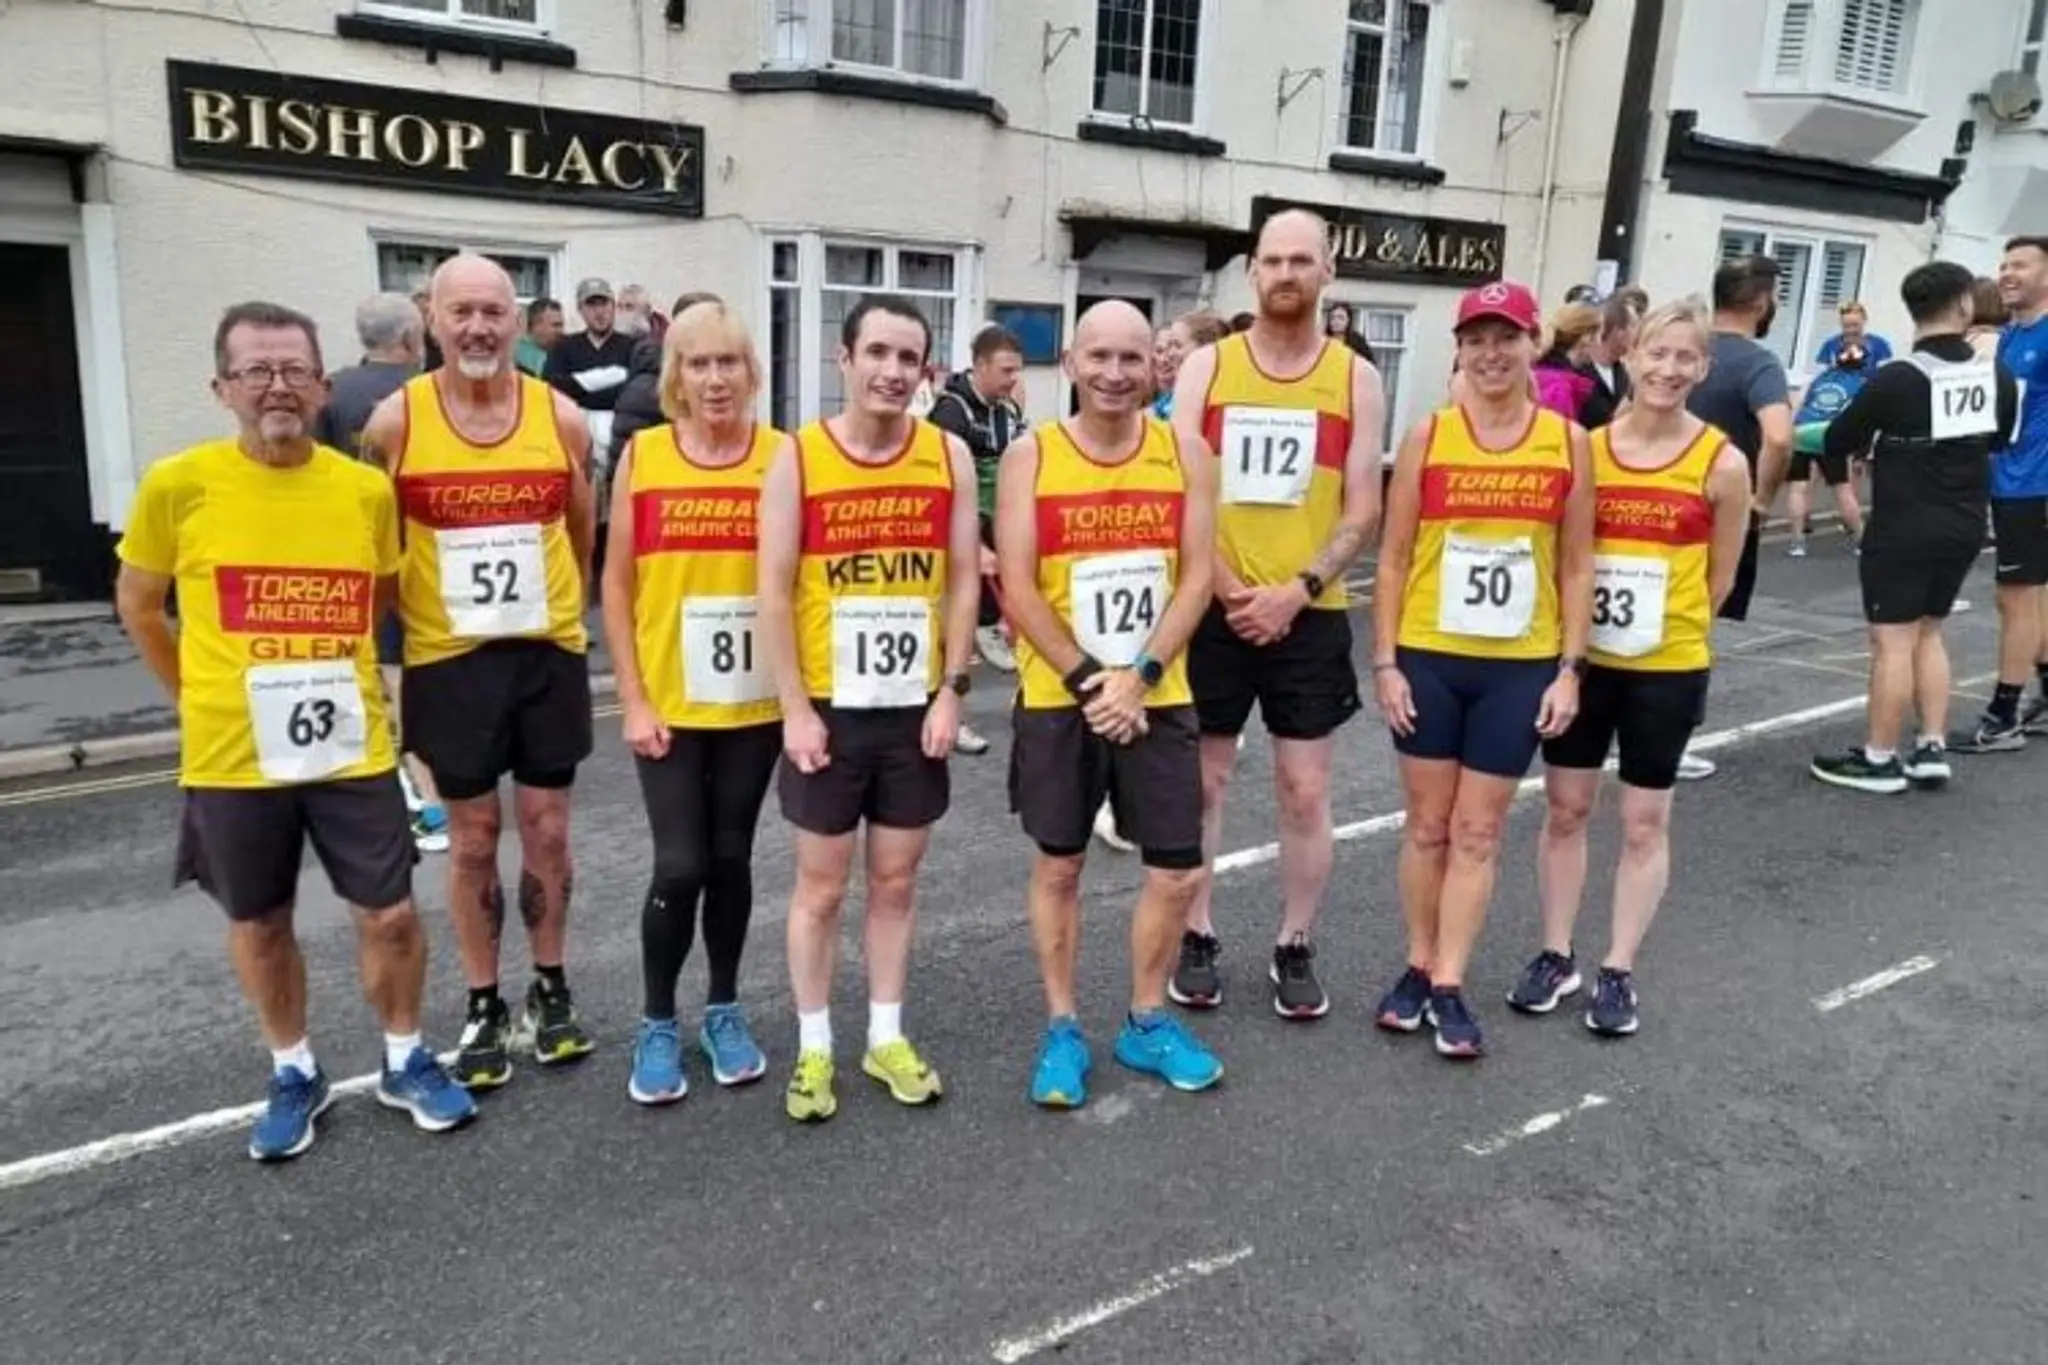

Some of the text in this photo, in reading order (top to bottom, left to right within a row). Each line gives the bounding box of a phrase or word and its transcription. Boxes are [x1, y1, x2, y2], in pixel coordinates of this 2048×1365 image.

[184, 87, 692, 194] BISHOP LACY
[1328, 221, 1498, 273] OD & ALES
[1942, 385, 1987, 417] 170
[1239, 435, 1301, 476] 112
[427, 483, 554, 504] TORBAY
[1444, 472, 1555, 491] TORBAY
[660, 497, 759, 518] TORBA
[820, 496, 932, 523] TORBAY
[1058, 502, 1172, 531] TORBAY
[1597, 498, 1685, 518] ORBAY
[661, 520, 734, 537] ATHLETIC
[243, 575, 364, 602] TORBAY
[472, 558, 521, 605] 52
[826, 552, 935, 590] KEVIN
[1463, 565, 1512, 607] 50
[245, 602, 321, 622] ATHLETIC
[1094, 586, 1155, 635] 124
[1592, 587, 1634, 627] 33
[249, 636, 358, 660] GLEN
[712, 630, 753, 673] 81
[855, 631, 919, 675] 139
[287, 699, 336, 747] 63
